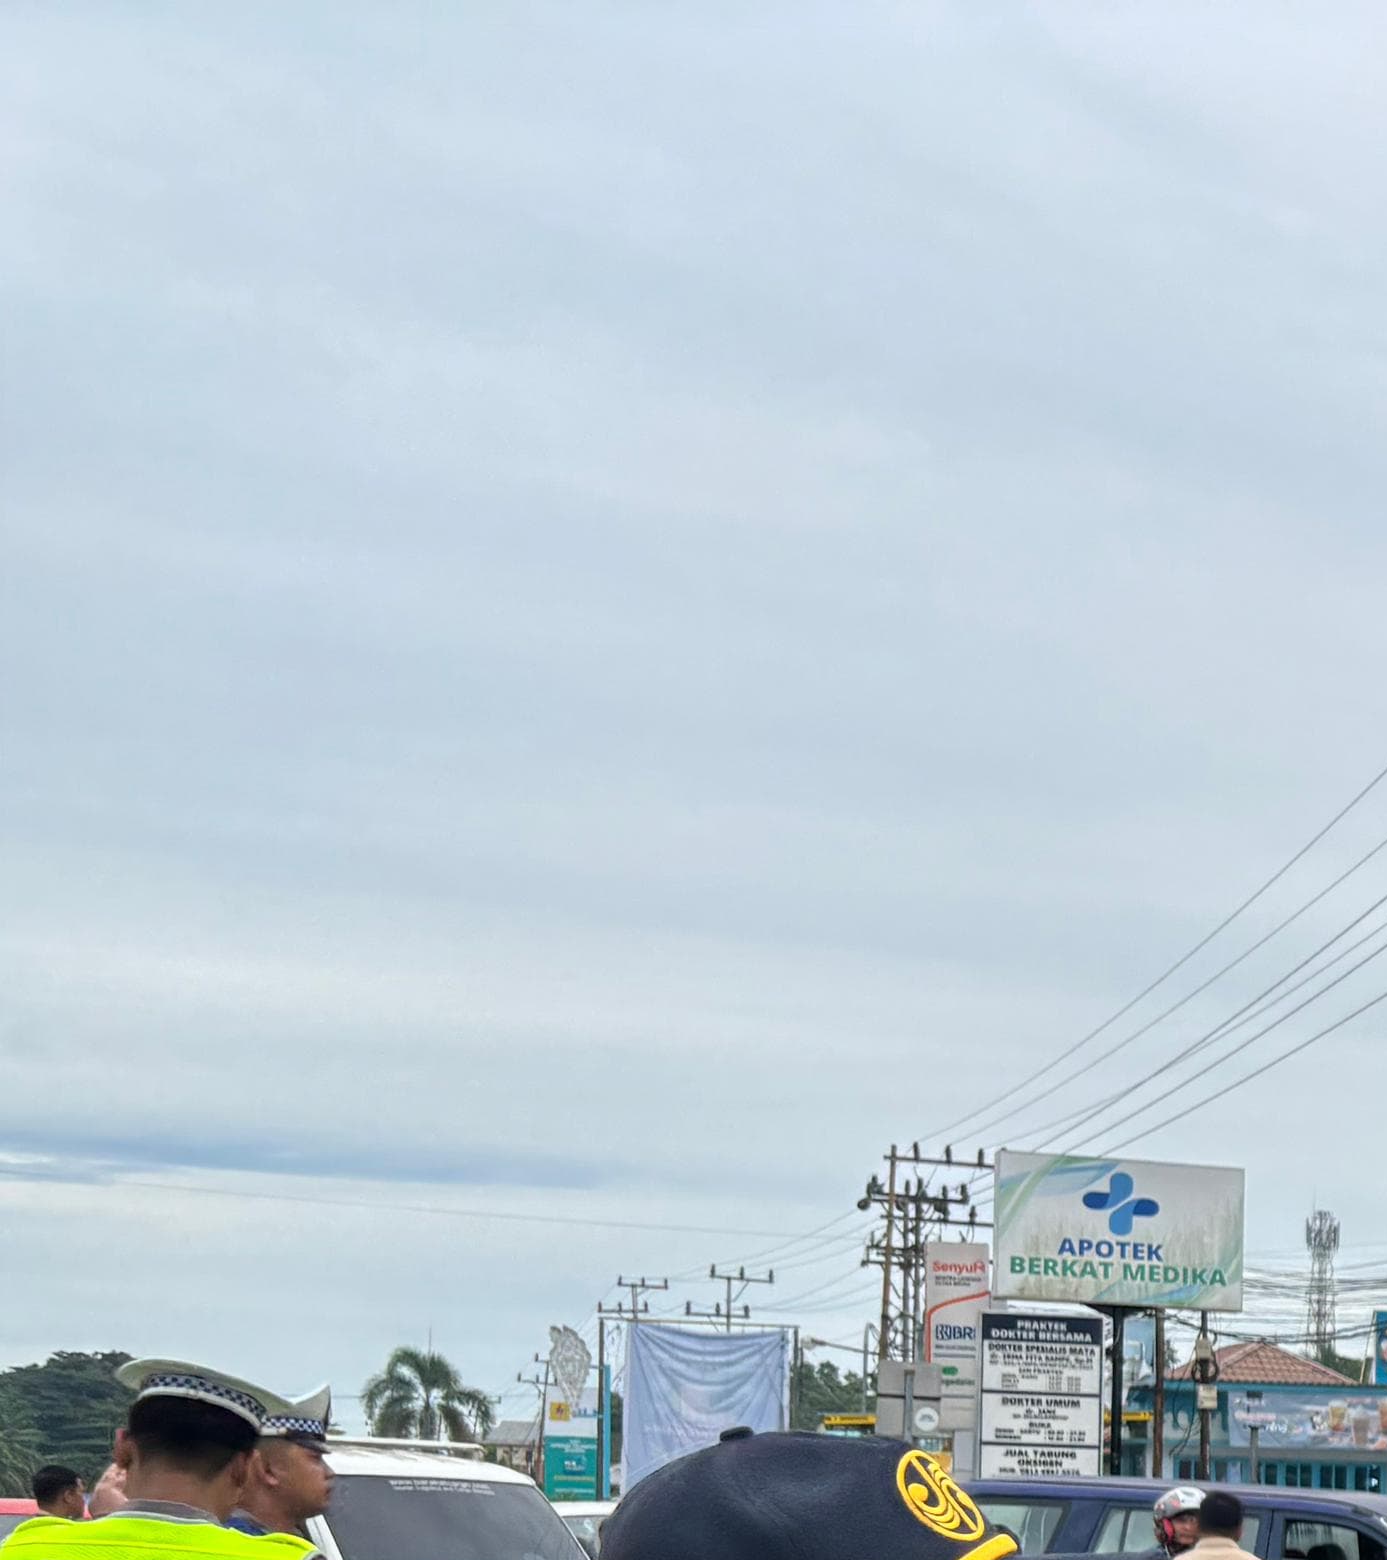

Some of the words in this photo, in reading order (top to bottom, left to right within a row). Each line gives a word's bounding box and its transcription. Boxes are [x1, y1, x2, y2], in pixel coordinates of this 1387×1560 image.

[1058, 1238, 1163, 1261] APOTEK
[1010, 1256, 1114, 1280] BERKAT
[1122, 1263, 1227, 1286] MEDIKA
[1017, 1320, 1068, 1331] PRAKTEK
[991, 1328, 1036, 1339] DOKTER
[1038, 1331, 1093, 1343] BERSAMA
[988, 1343, 1023, 1352] DOKTER
[1002, 1397, 1042, 1406] DOKTER
[1046, 1399, 1081, 1408] UMUM
[1004, 1450, 1029, 1458] JUAL
[1033, 1451, 1077, 1460] TABUNG
